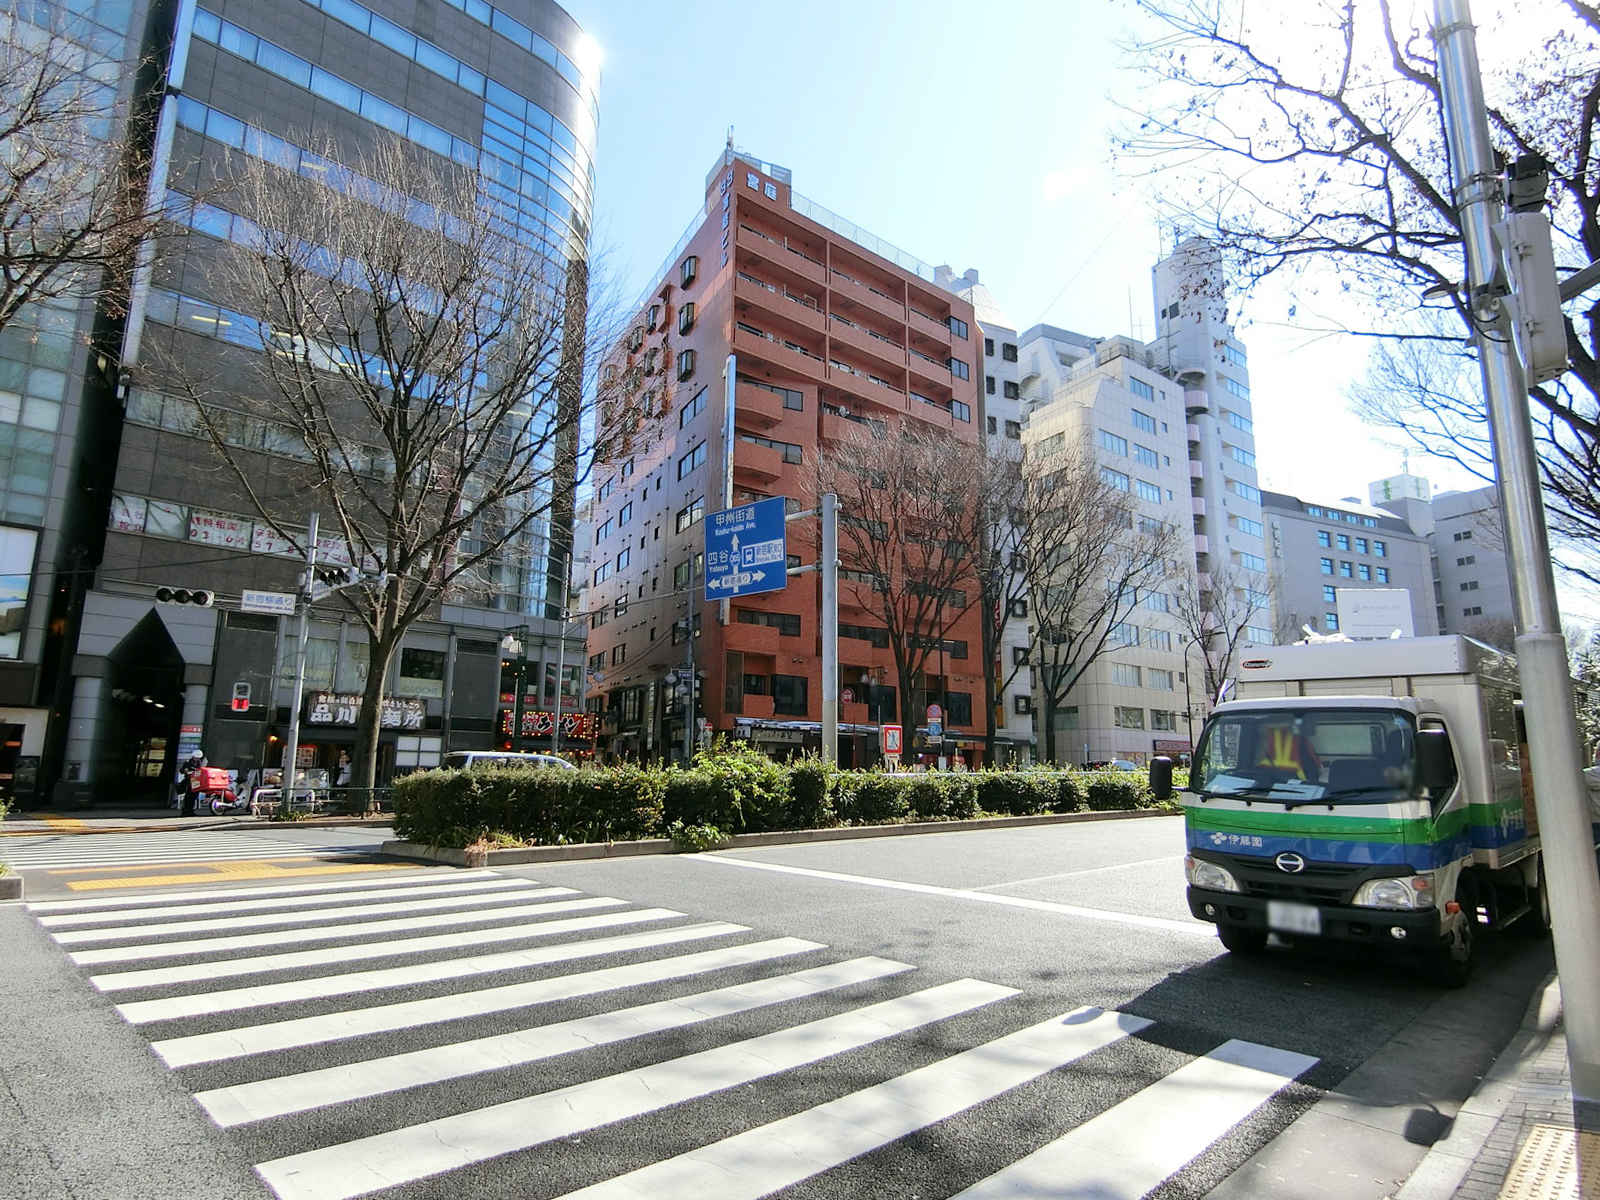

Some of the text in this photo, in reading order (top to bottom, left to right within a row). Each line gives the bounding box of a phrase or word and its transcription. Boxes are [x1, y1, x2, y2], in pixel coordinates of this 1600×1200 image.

[716, 507, 755, 526] 甲州街道
[709, 550, 728, 565] 四谷
[708, 565, 729, 573] Yotsuya
[245, 593, 293, 606] 新宿柳通り
[1228, 834, 1263, 848] 伊藤園
